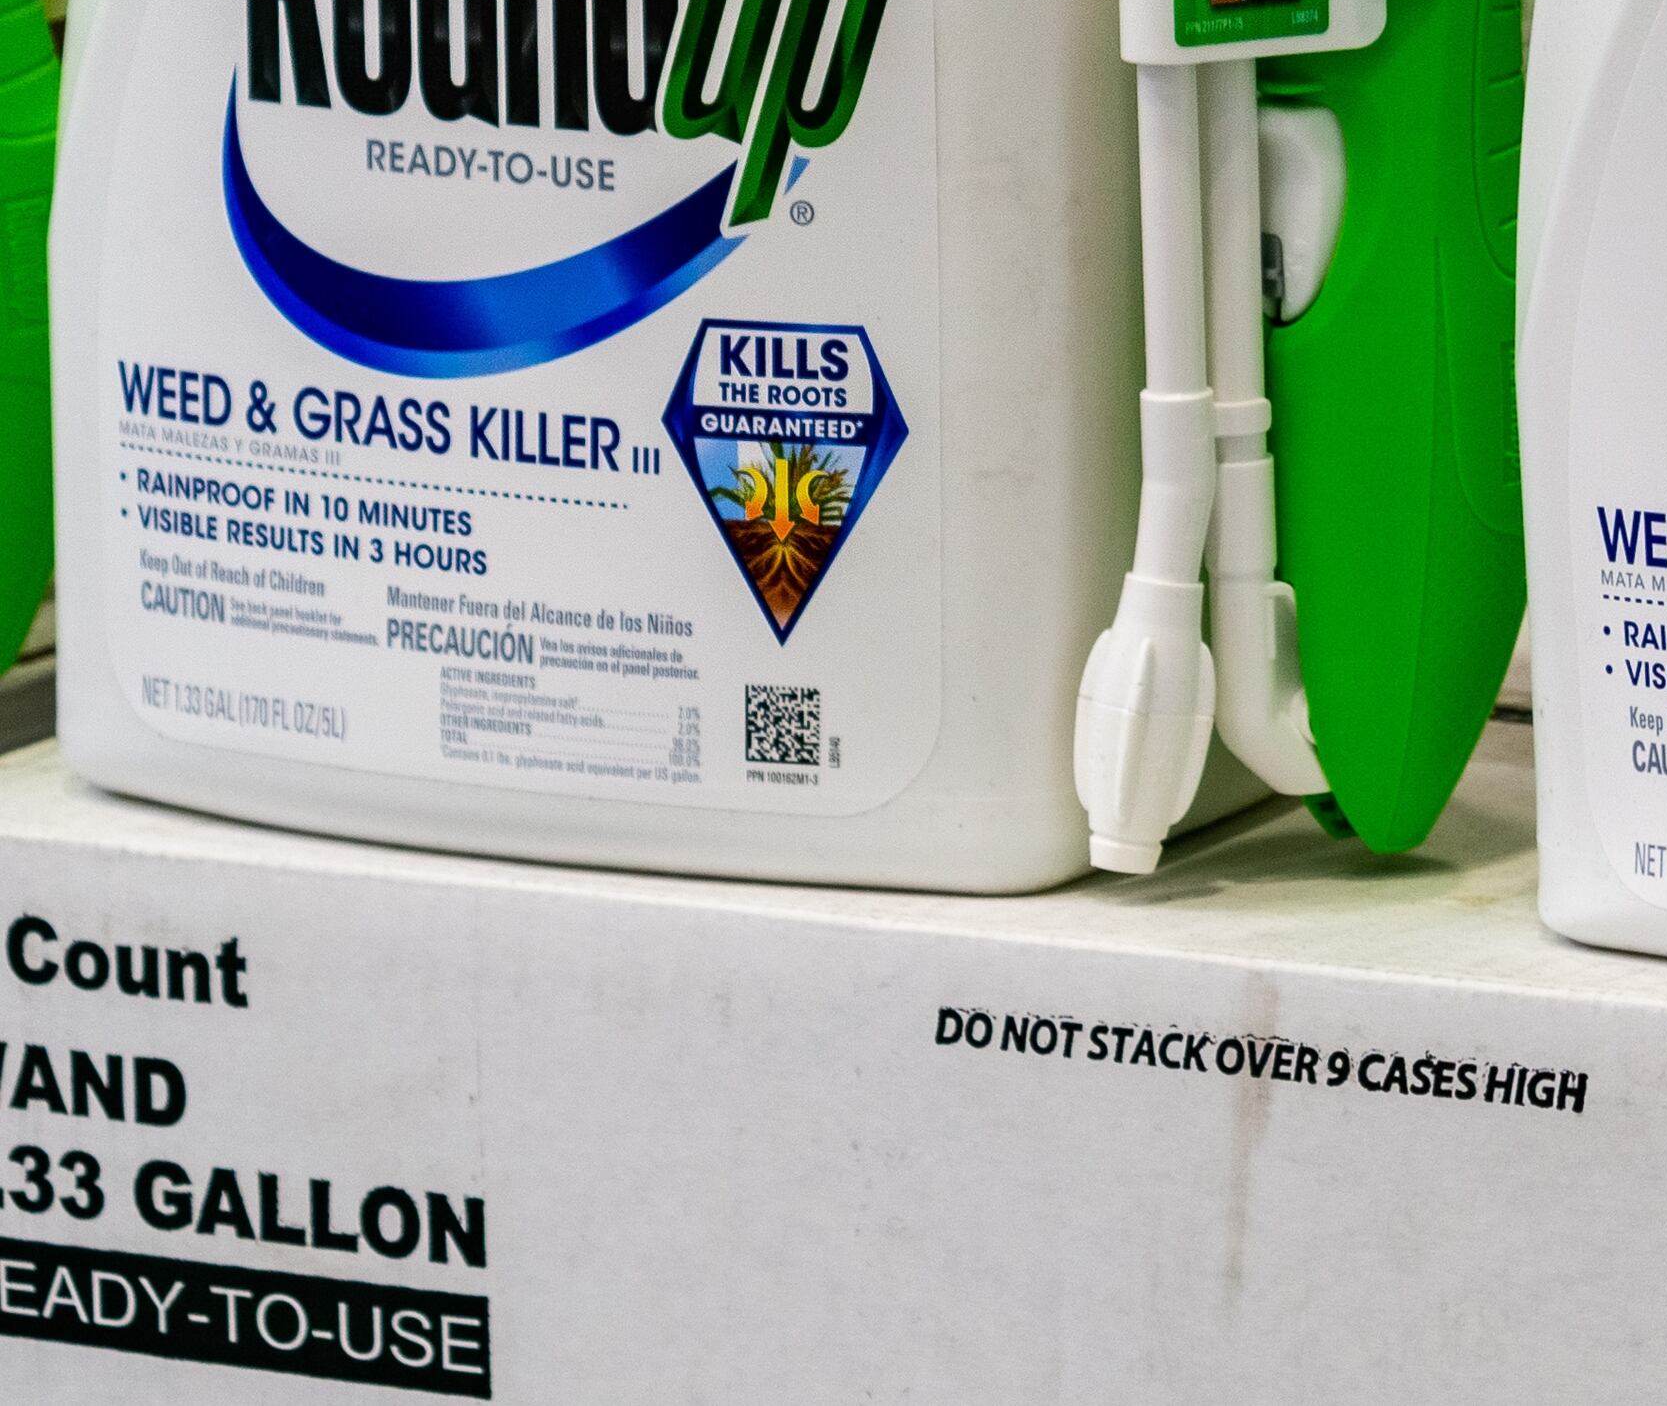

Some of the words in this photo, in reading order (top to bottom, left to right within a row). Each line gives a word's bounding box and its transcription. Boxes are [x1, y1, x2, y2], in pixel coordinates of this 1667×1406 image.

[366, 138, 615, 192] READY-TO-USE
[720, 335, 849, 381] KILLS
[118, 360, 231, 426] WEED
[246, 380, 277, 434] &
[293, 387, 451, 454] GRASS
[470, 405, 619, 472] KILLER
[633, 447, 660, 475] III
[720, 382, 760, 406] THE
[768, 387, 847, 408] ROOTS
[137, 469, 275, 511] RAINPROOF
[285, 491, 309, 517] IN
[322, 495, 348, 521] 10
[358, 501, 472, 536] MINUTES
[138, 505, 217, 540] VISIBLE
[227, 520, 324, 556] RESULTS
[334, 535, 358, 560] IN
[369, 538, 383, 563] 3
[394, 542, 487, 575] HOURS
[1601, 569, 1645, 590] MATA
[1630, 706, 1663, 736] Keep
[1635, 842, 1666, 878] NET
[6, 916, 248, 1008] Count
[0, 1042, 187, 1127] AND
[935, 1007, 993, 1048] DO
[1000, 1013, 1083, 1059] NOT
[1087, 1023, 1210, 1072] STACK
[1215, 1034, 1318, 1084] OVER
[1326, 1048, 1352, 1087] 9
[1357, 1051, 1478, 1099] CASES
[1484, 1063, 1588, 1114] HIGH
[134, 1159, 487, 1269] GALLON
